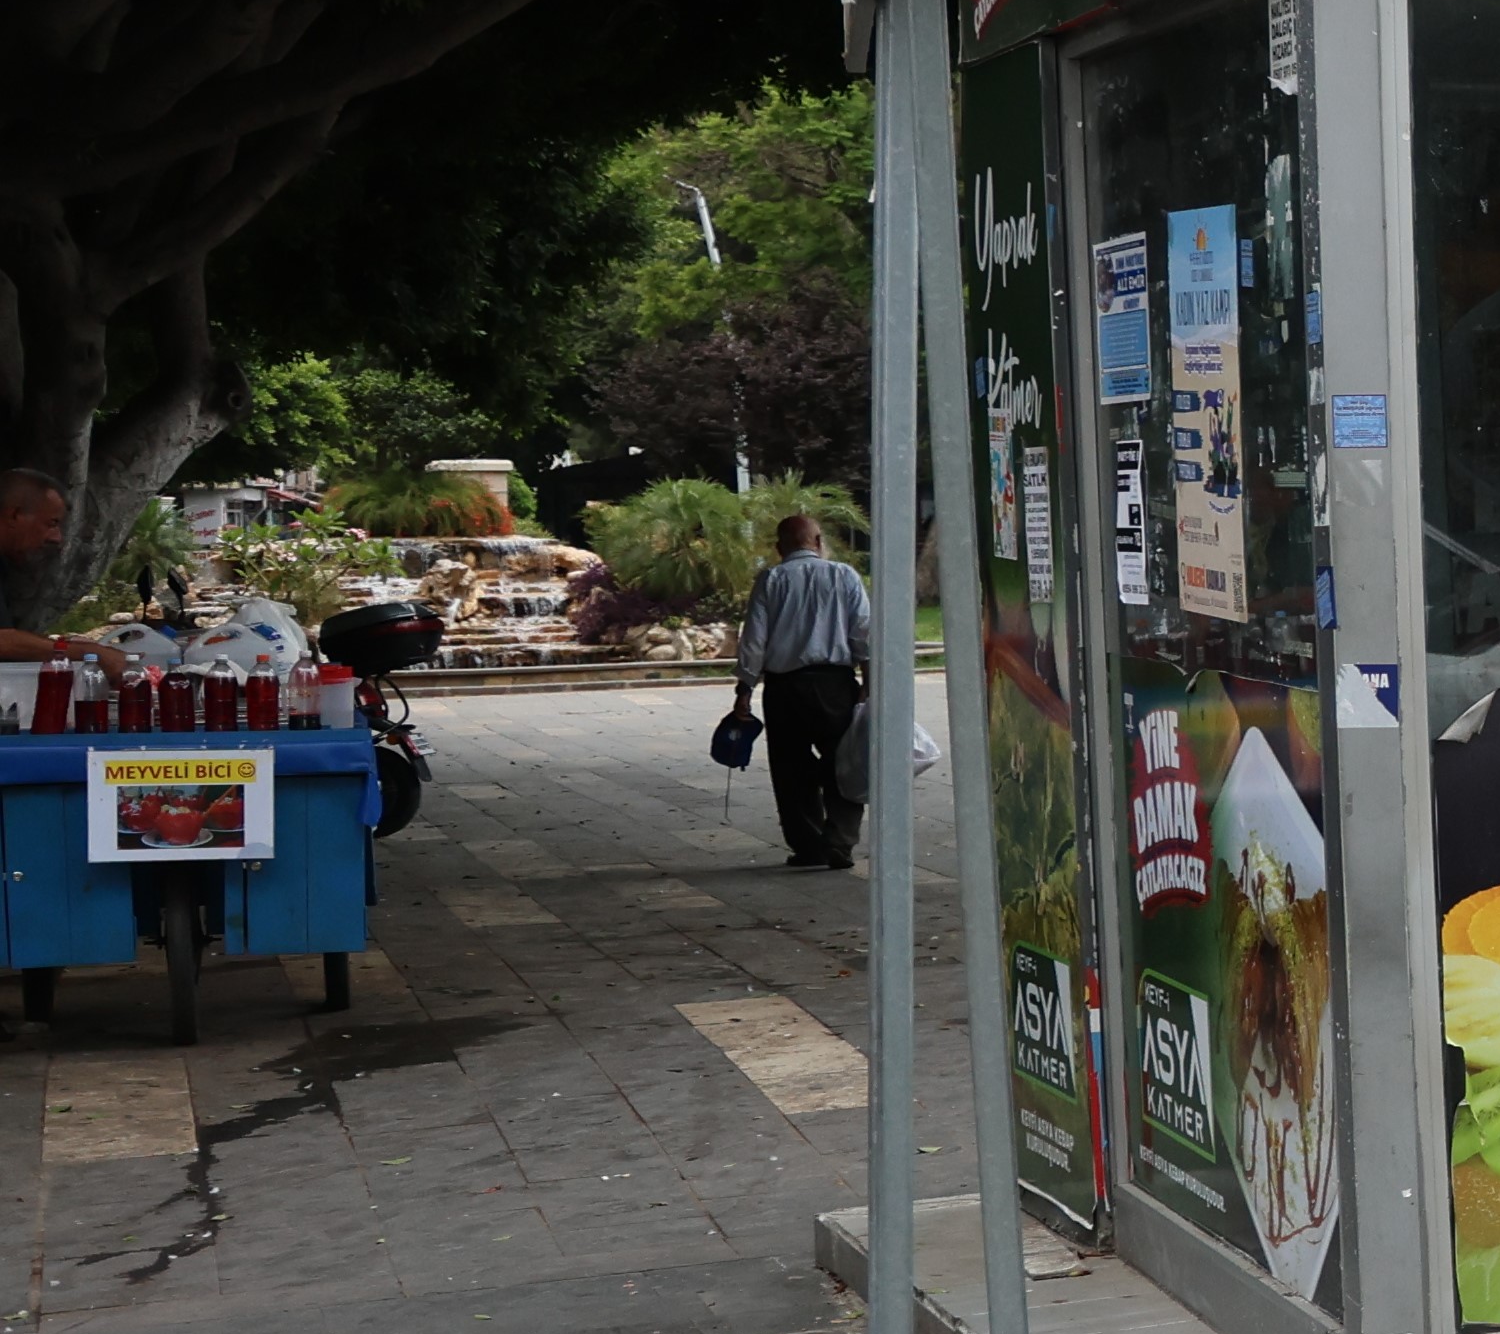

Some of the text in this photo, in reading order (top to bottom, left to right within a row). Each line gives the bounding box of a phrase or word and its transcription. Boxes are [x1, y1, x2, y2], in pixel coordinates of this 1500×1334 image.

[975, 167, 1038, 311] Yaprak
[105, 761, 232, 780] MEYVELİ BİCİ
[1133, 781, 1199, 853] DAMAK
[1014, 978, 1069, 1056] ASYA
[1018, 1041, 1068, 1089] KATMER
[1142, 1011, 1207, 1105] ASYA
[1146, 1089, 1206, 1143] KATMER
